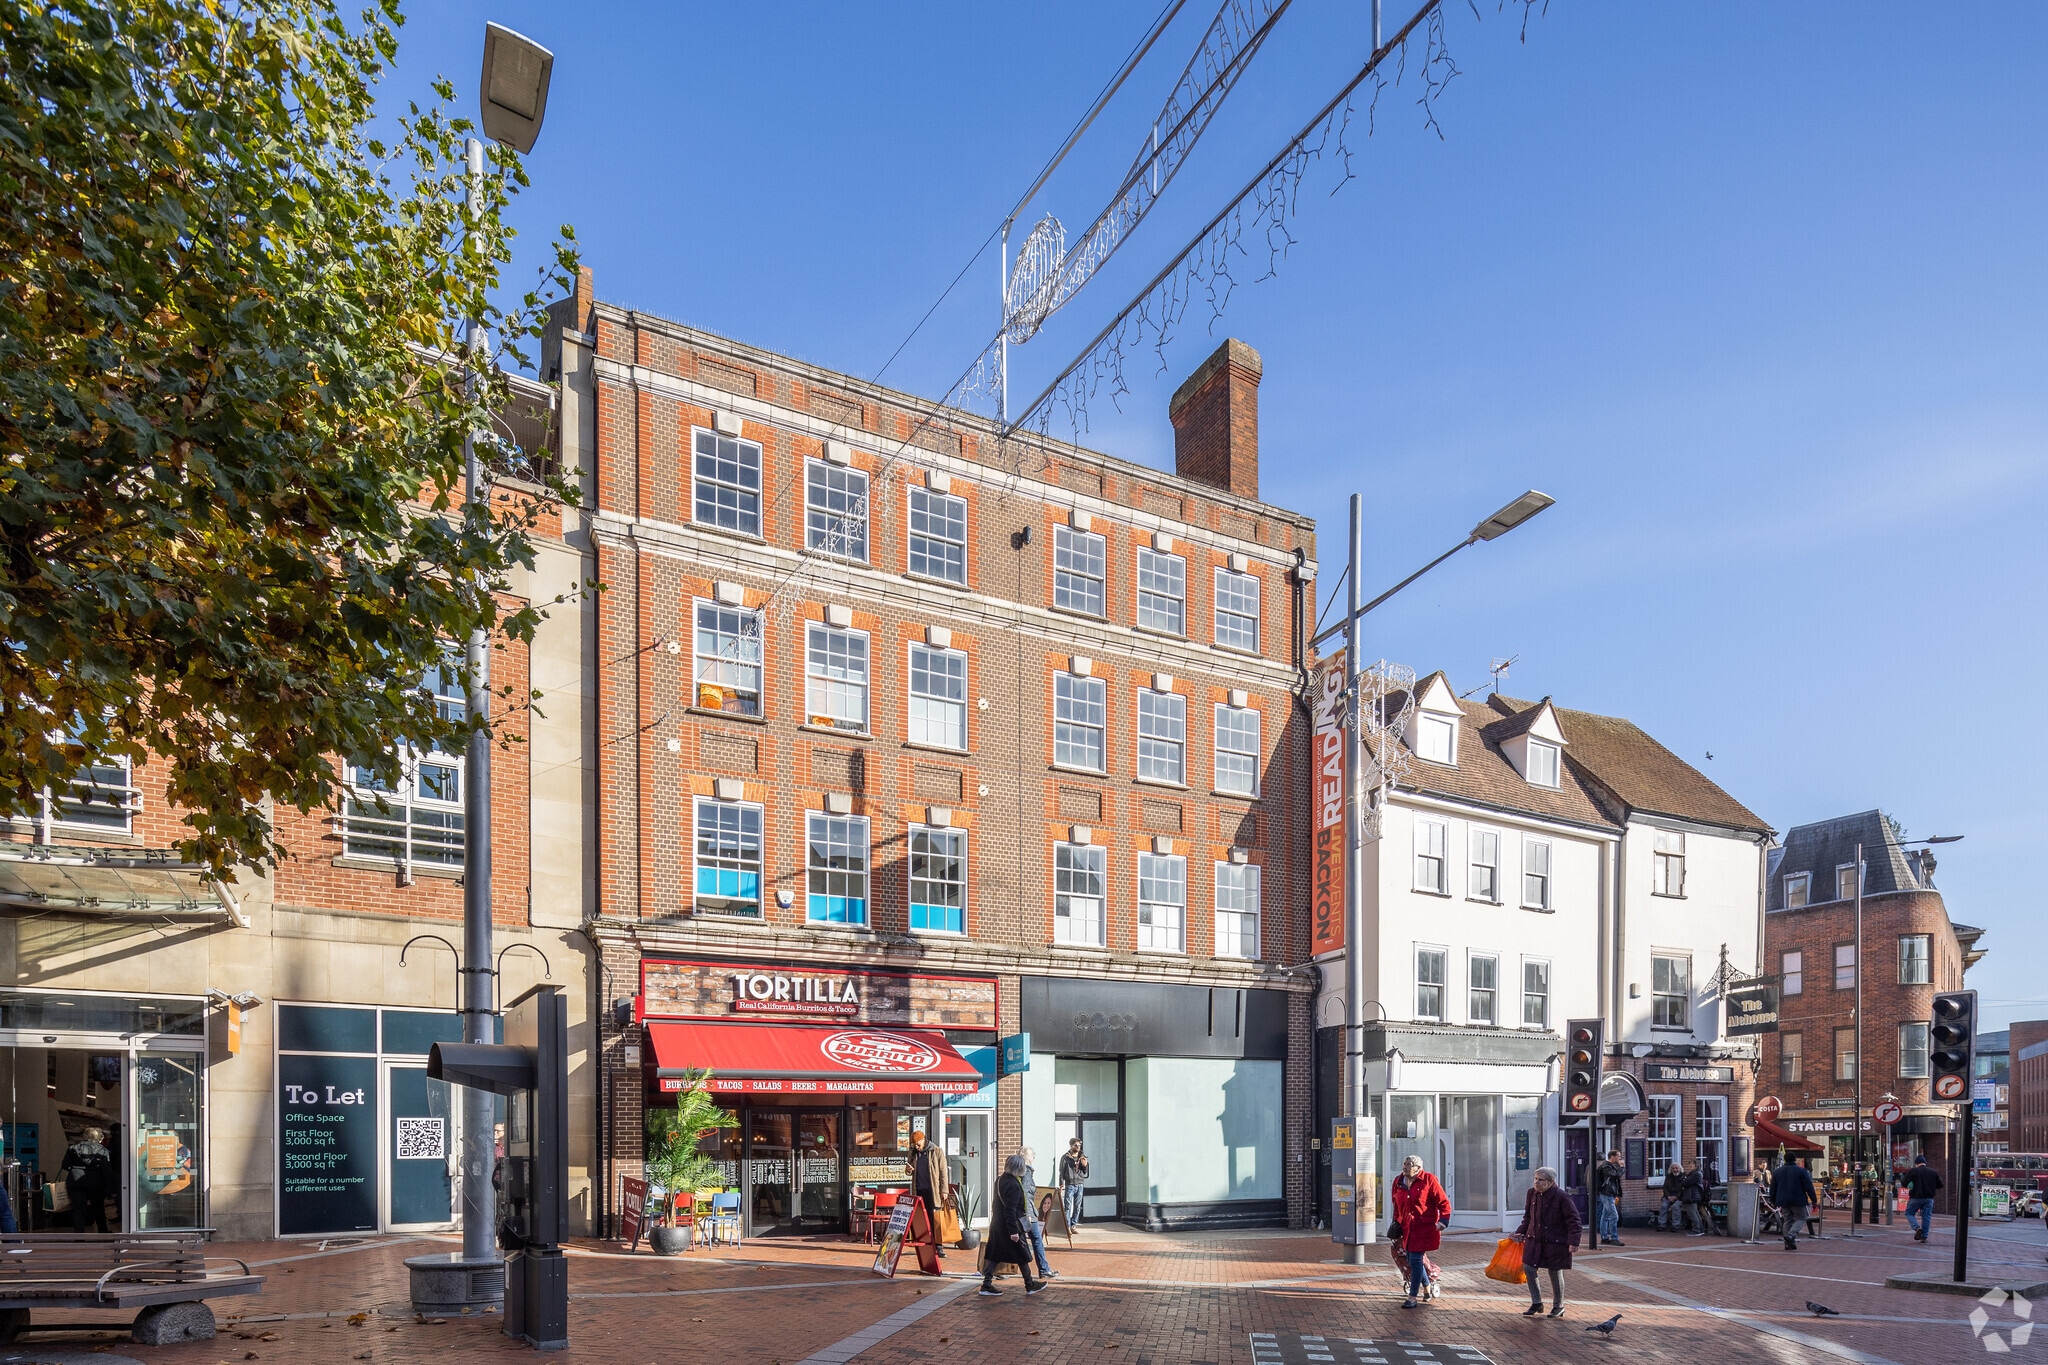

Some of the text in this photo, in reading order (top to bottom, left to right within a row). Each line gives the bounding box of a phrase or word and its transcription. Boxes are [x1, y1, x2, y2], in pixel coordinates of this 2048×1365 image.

[1316, 671, 1342, 828] READING
[1317, 829, 1331, 900] BACK
[1331, 825, 1342, 937] LIVE EVENTS
[1316, 900, 1331, 941] ON
[735, 974, 859, 1003] TORTILLA
[739, 1001, 757, 1009] Real
[757, 1002, 795, 1010] California
[796, 1004, 827, 1012] Burritos
[1741, 1000, 1763, 1011] The
[1728, 1012, 1778, 1027] Alehouse
[835, 1042, 926, 1064] BURRITO
[1660, 1066, 1720, 1081] The Alehouse
[717, 1081, 743, 1090] TACOS
[752, 1082, 782, 1090] SALADS
[791, 1082, 817, 1091] BEERS
[826, 1082, 874, 1091] MARGARITAS
[919, 1083, 974, 1091] TORTILLA.CO.UK
[285, 1085, 364, 1105] To Let
[948, 1093, 991, 1102] DENTISTS
[1760, 1105, 1779, 1113] COSTA
[285, 1113, 345, 1124] Office Space
[285, 1129, 334, 1137] First Floor
[285, 1137, 336, 1147] 3,000 sq ft
[285, 1152, 348, 1161] Second Floor
[853, 1157, 888, 1165] GUACAMOLE
[285, 1160, 336, 1170] 3,000 sq ft
[803, 1175, 828, 1184] URRITOS!
[285, 1185, 294, 1193] of
